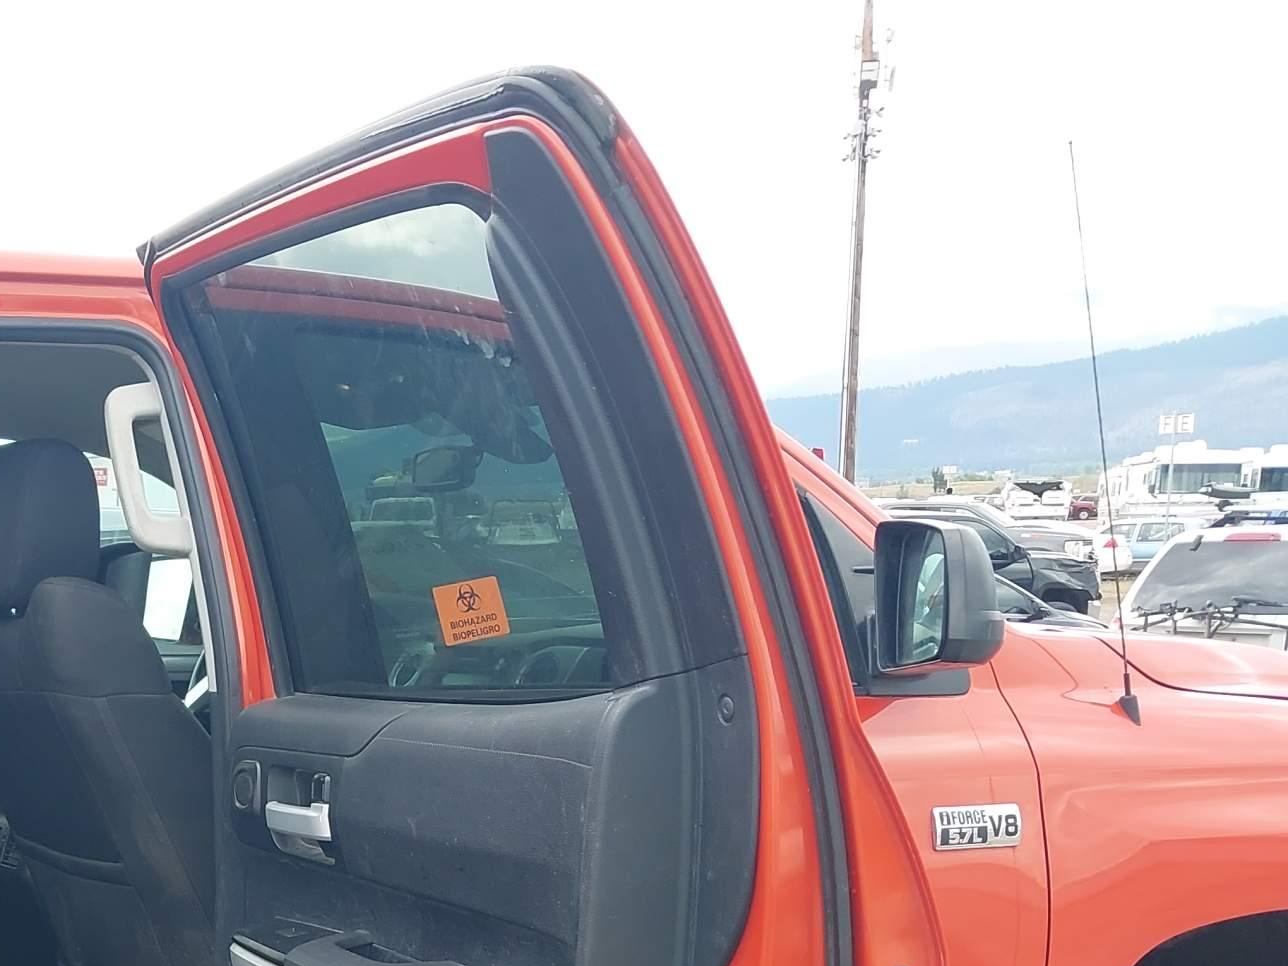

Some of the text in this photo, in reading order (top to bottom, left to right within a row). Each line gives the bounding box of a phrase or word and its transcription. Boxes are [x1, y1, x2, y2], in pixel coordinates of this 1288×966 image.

[450, 613, 497, 630] BIOHAZARD
[452, 624, 501, 641] BIOPELIGRO
[988, 814, 1019, 837] V8
[948, 827, 983, 844] 5.7L
